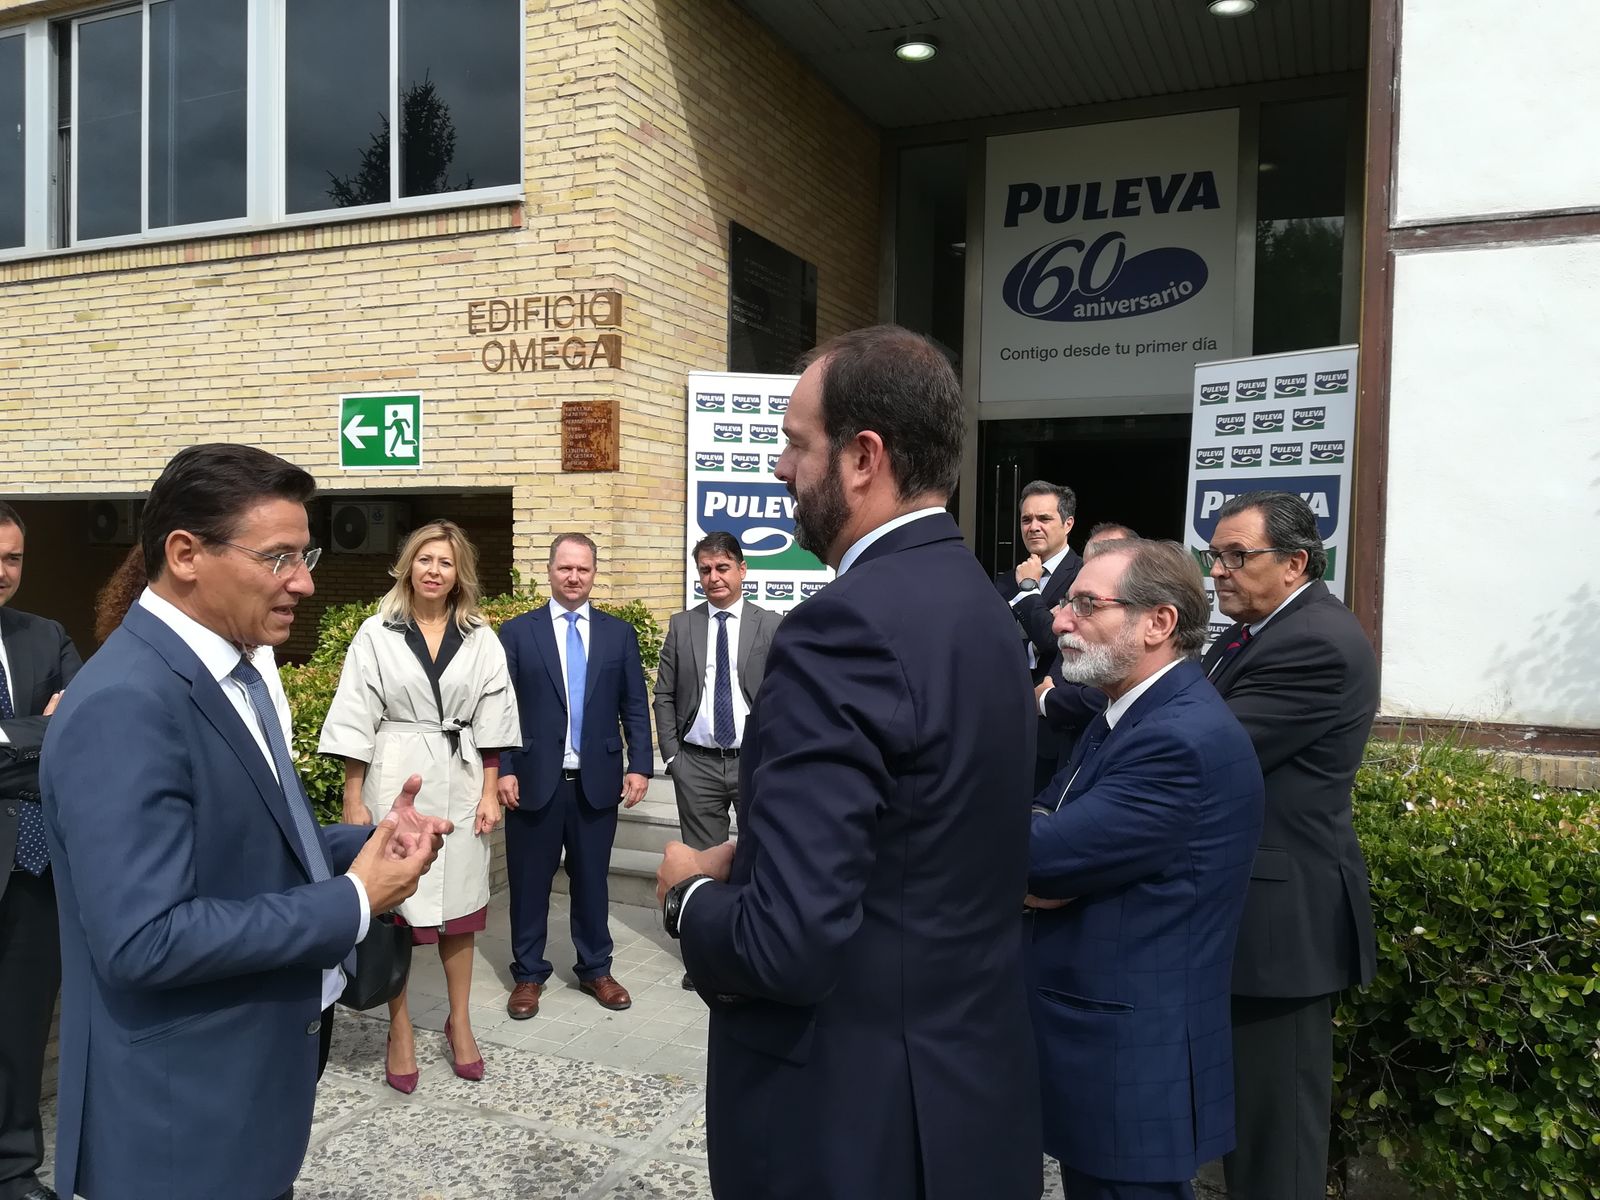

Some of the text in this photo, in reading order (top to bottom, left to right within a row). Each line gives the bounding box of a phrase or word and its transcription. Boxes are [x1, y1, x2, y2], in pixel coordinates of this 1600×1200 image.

[1004, 171, 1220, 228] PULEVA
[1017, 231, 1126, 316] 60
[1073, 279, 1193, 318] aniversario
[468, 292, 622, 334] EDIFICIO
[482, 334, 621, 373] OMEGA
[1000, 336, 1218, 362] Contigo desde tu primer día
[1202, 373, 1347, 394] PULEVA PULEVA PULEVA PULEVA
[697, 394, 724, 402] PULEVA
[733, 395, 760, 403] PULEVA
[714, 424, 777, 433] PULEVA PULEVA
[1217, 409, 1324, 424] PULEVA PULEVA PULEVA
[696, 453, 723, 461] PULEVA
[732, 454, 759, 462] PULEVA
[1197, 442, 1343, 458] PULEVA PULEVA PULEVA PULEVA
[703, 491, 798, 519] PULEV
